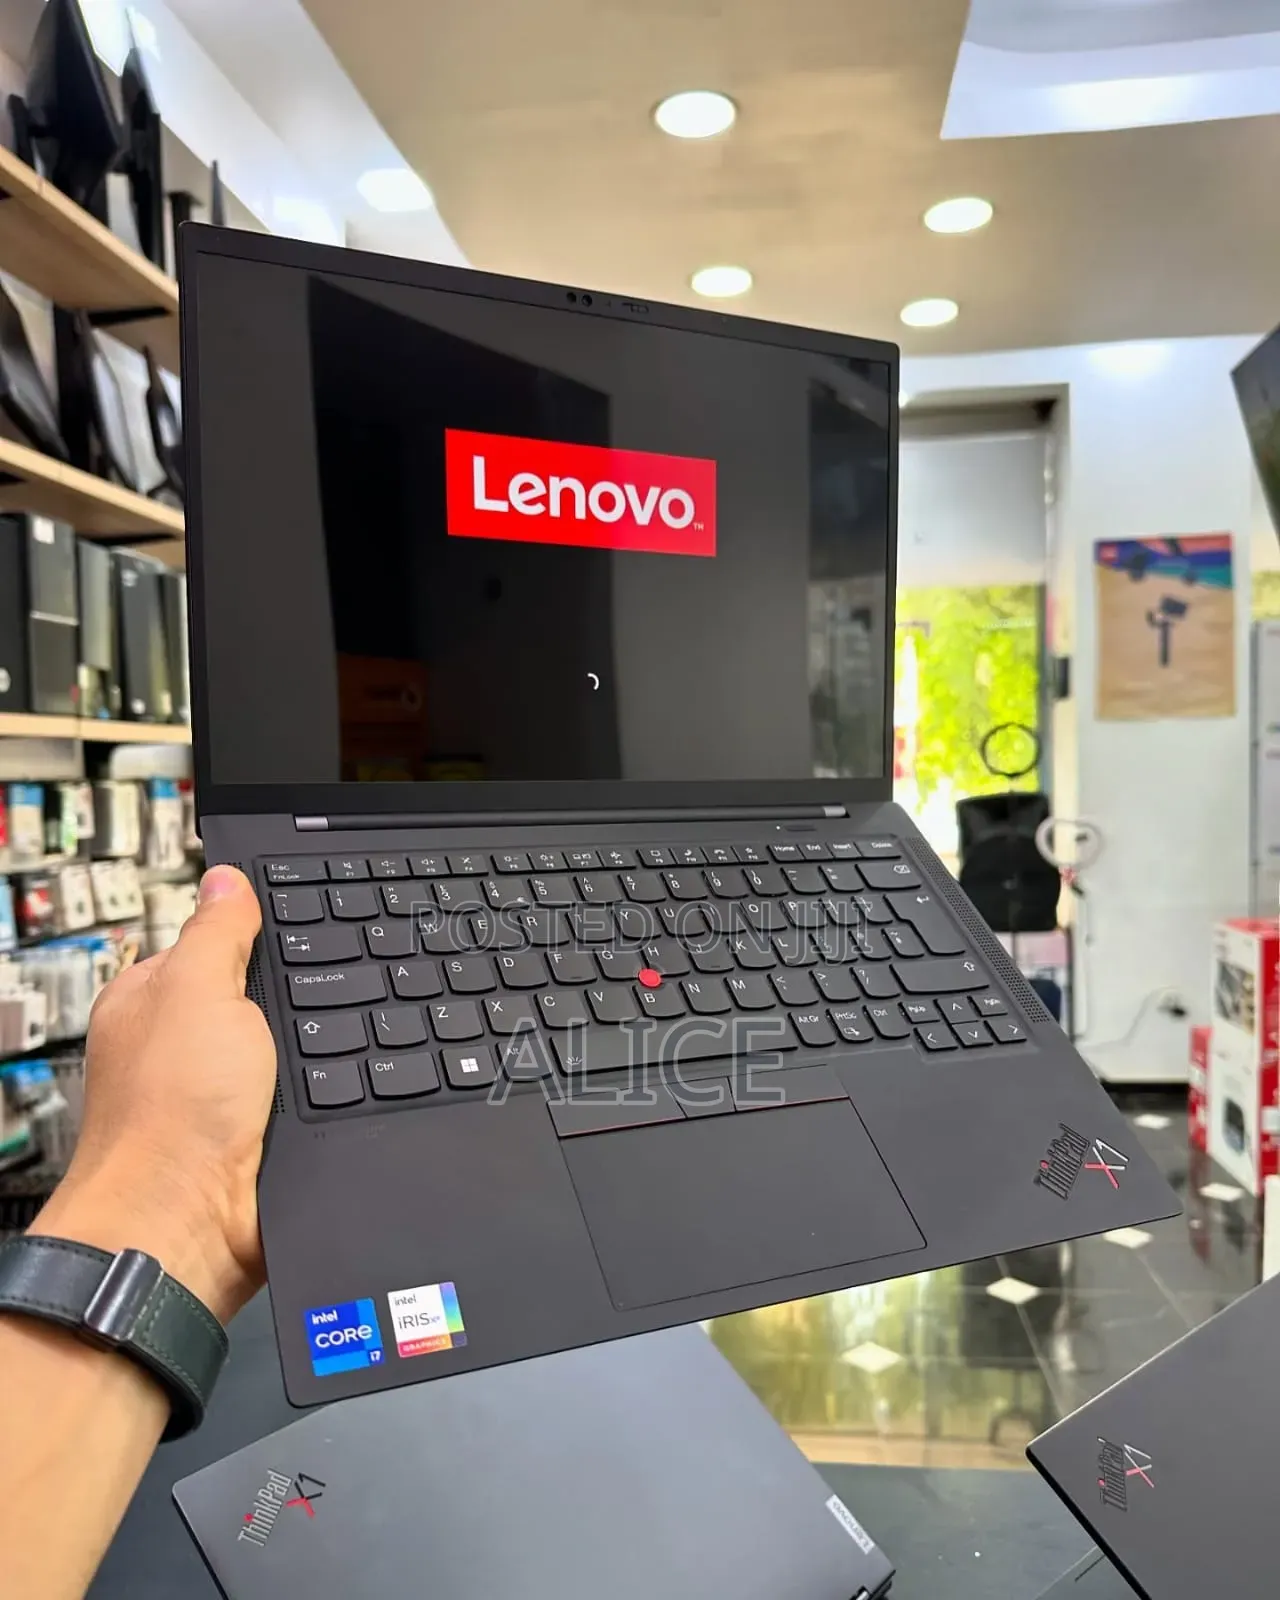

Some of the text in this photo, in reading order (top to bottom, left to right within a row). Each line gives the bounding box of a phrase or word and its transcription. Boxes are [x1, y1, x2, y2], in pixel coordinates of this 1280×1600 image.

[473, 455, 695, 529] Lenovo
[477, 919, 488, 930] E
[526, 916, 538, 927] R
[371, 926, 385, 937] Q
[601, 950, 613, 960] G
[451, 961, 463, 972] S
[503, 957, 515, 968] D
[397, 966, 409, 977] A
[294, 972, 345, 985] CapsLock
[688, 983, 701, 994] N
[732, 979, 747, 990] M
[543, 996, 556, 1007] C
[593, 991, 604, 1002] V
[644, 993, 656, 1003] B
[436, 1006, 449, 1019] Z
[491, 1001, 504, 1013] X
[375, 1061, 394, 1073] Ctrl
[313, 1070, 327, 1080] Fn
[1033, 1122, 1091, 1201] ThinkPad
[1084, 1138, 1129, 1190] X1
[394, 1294, 417, 1307] intel
[312, 1309, 338, 1325] intel
[1123, 1443, 1155, 1489] X1
[286, 1472, 326, 1519] X1
[237, 1468, 293, 1547] ThinkPad
